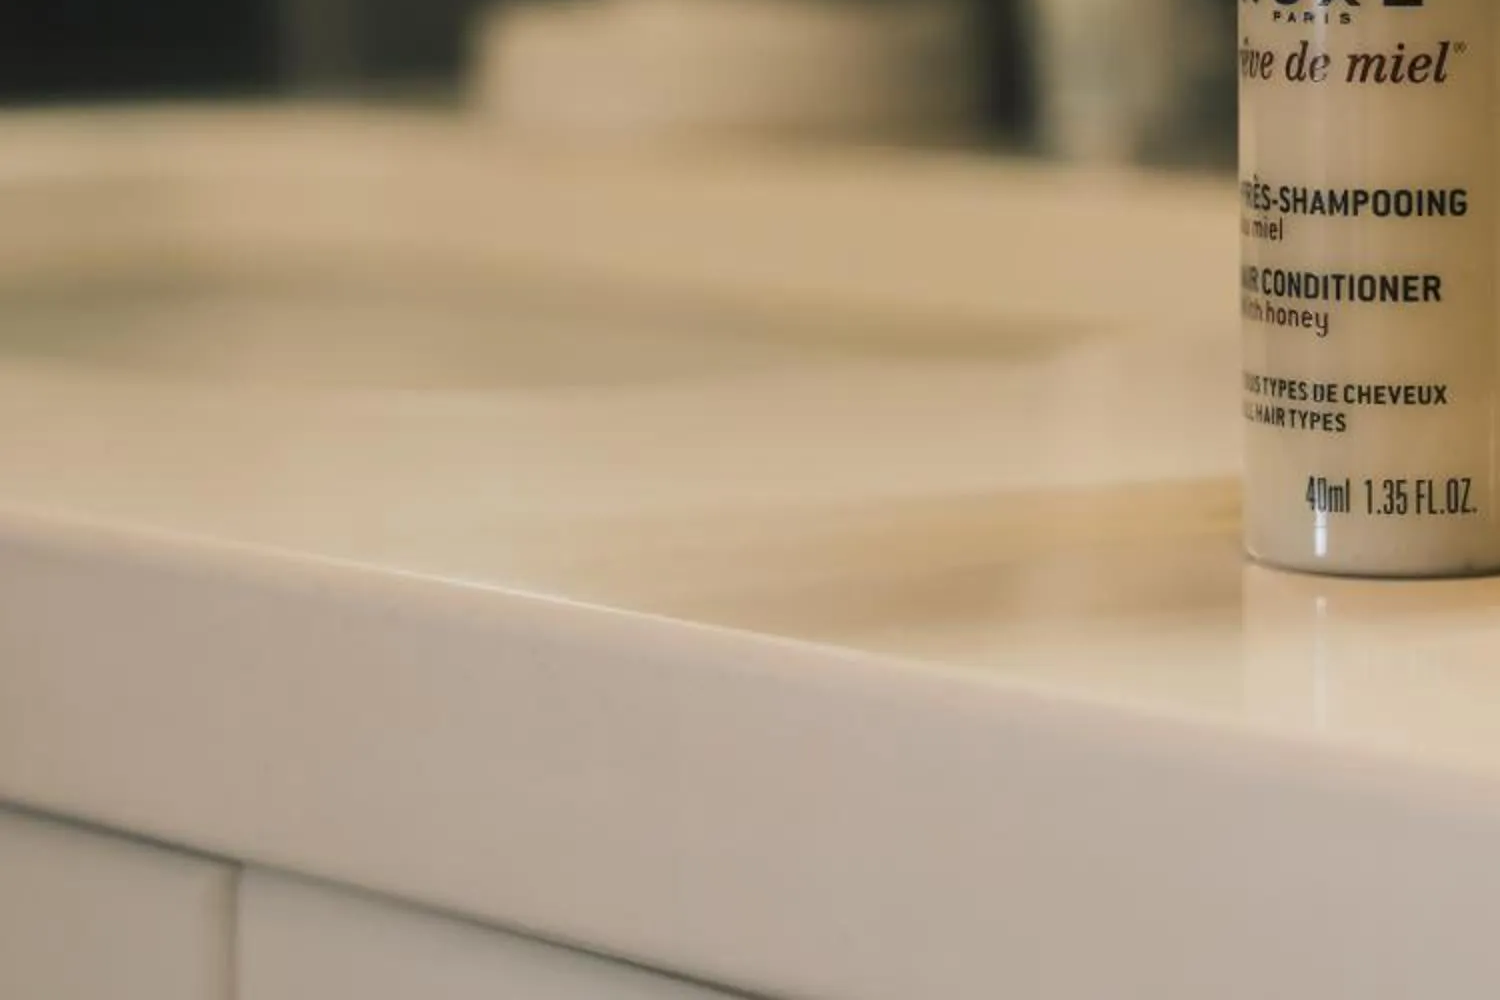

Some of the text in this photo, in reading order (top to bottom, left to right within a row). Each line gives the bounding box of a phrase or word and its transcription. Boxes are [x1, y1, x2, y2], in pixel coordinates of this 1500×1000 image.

[1273, 11, 1352, 25] PARIS
[1285, 41, 1331, 82] de
[1252, 215, 1284, 241] miel
[1262, 267, 1442, 303] CONDITIONER
[1265, 301, 1329, 338] honey
[1263, 375, 1308, 402] TYPES
[1314, 384, 1337, 403] DE
[1343, 384, 1447, 405] CHEVEUX
[1255, 403, 1285, 428] HAIR
[1288, 408, 1347, 433] TYPES
[1306, 475, 1478, 515] 40ml 1.35 FL.OZ.
